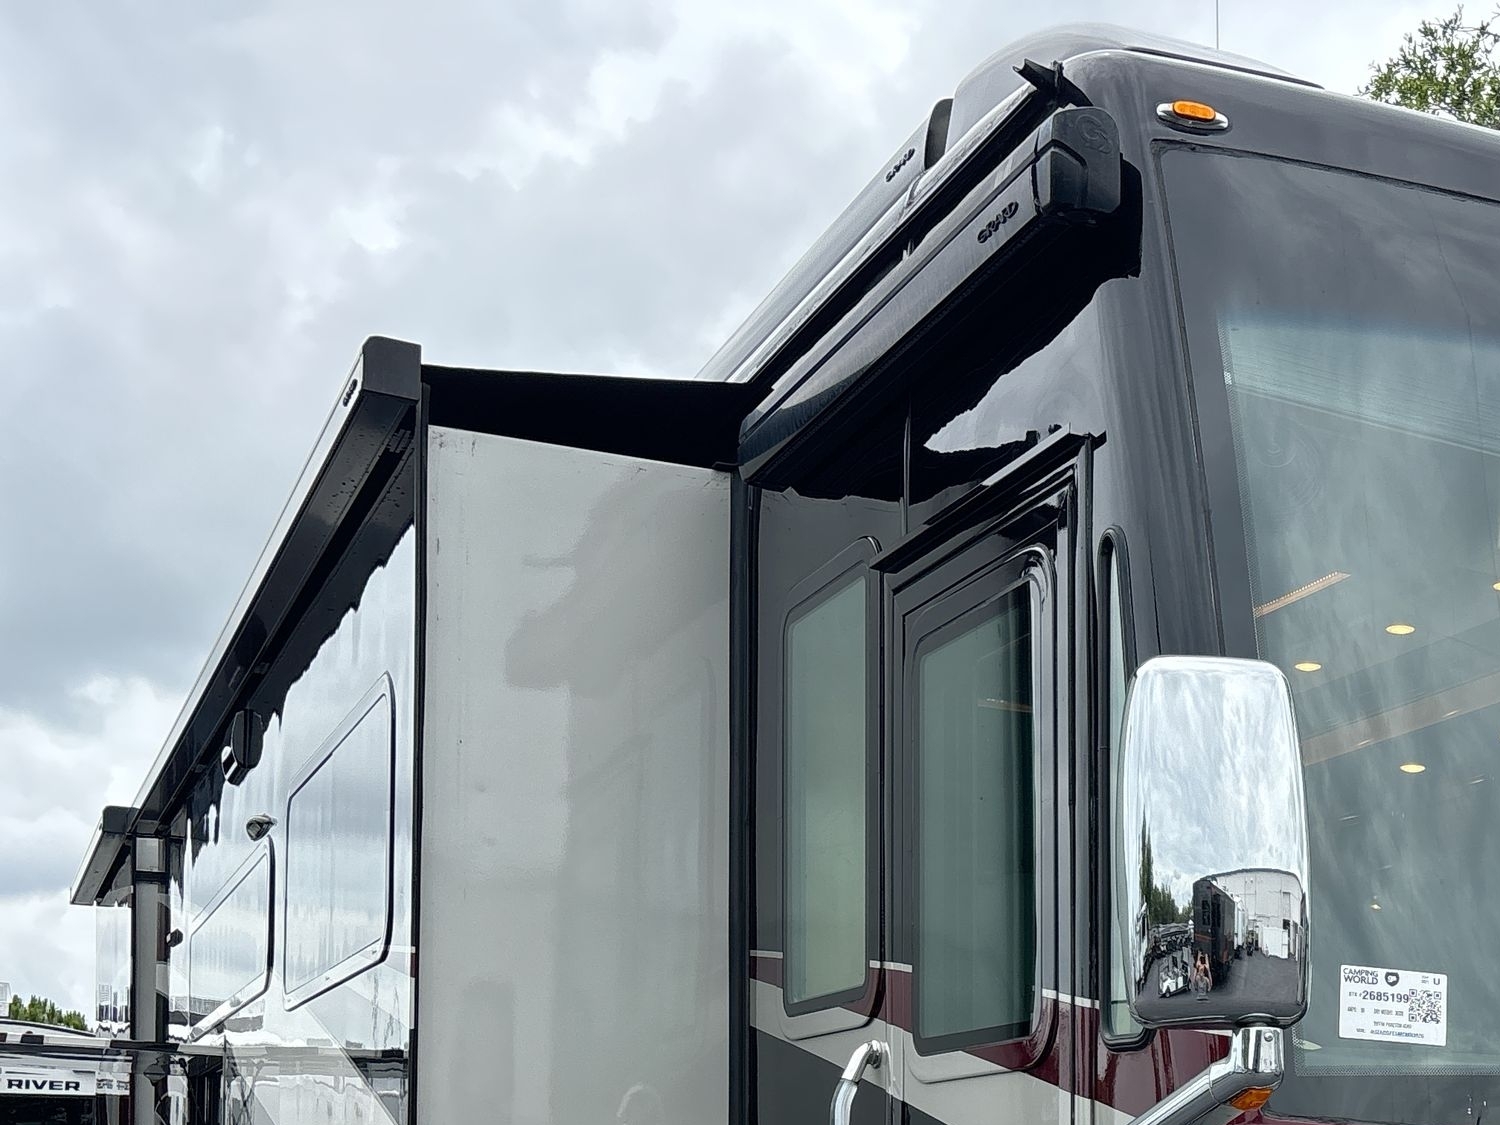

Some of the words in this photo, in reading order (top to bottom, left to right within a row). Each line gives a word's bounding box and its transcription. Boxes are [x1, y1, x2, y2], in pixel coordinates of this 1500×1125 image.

[1343, 968, 1379, 977] CAMPING
[1343, 975, 1379, 985] WORLD
[7, 1079, 80, 1091] RIVER
